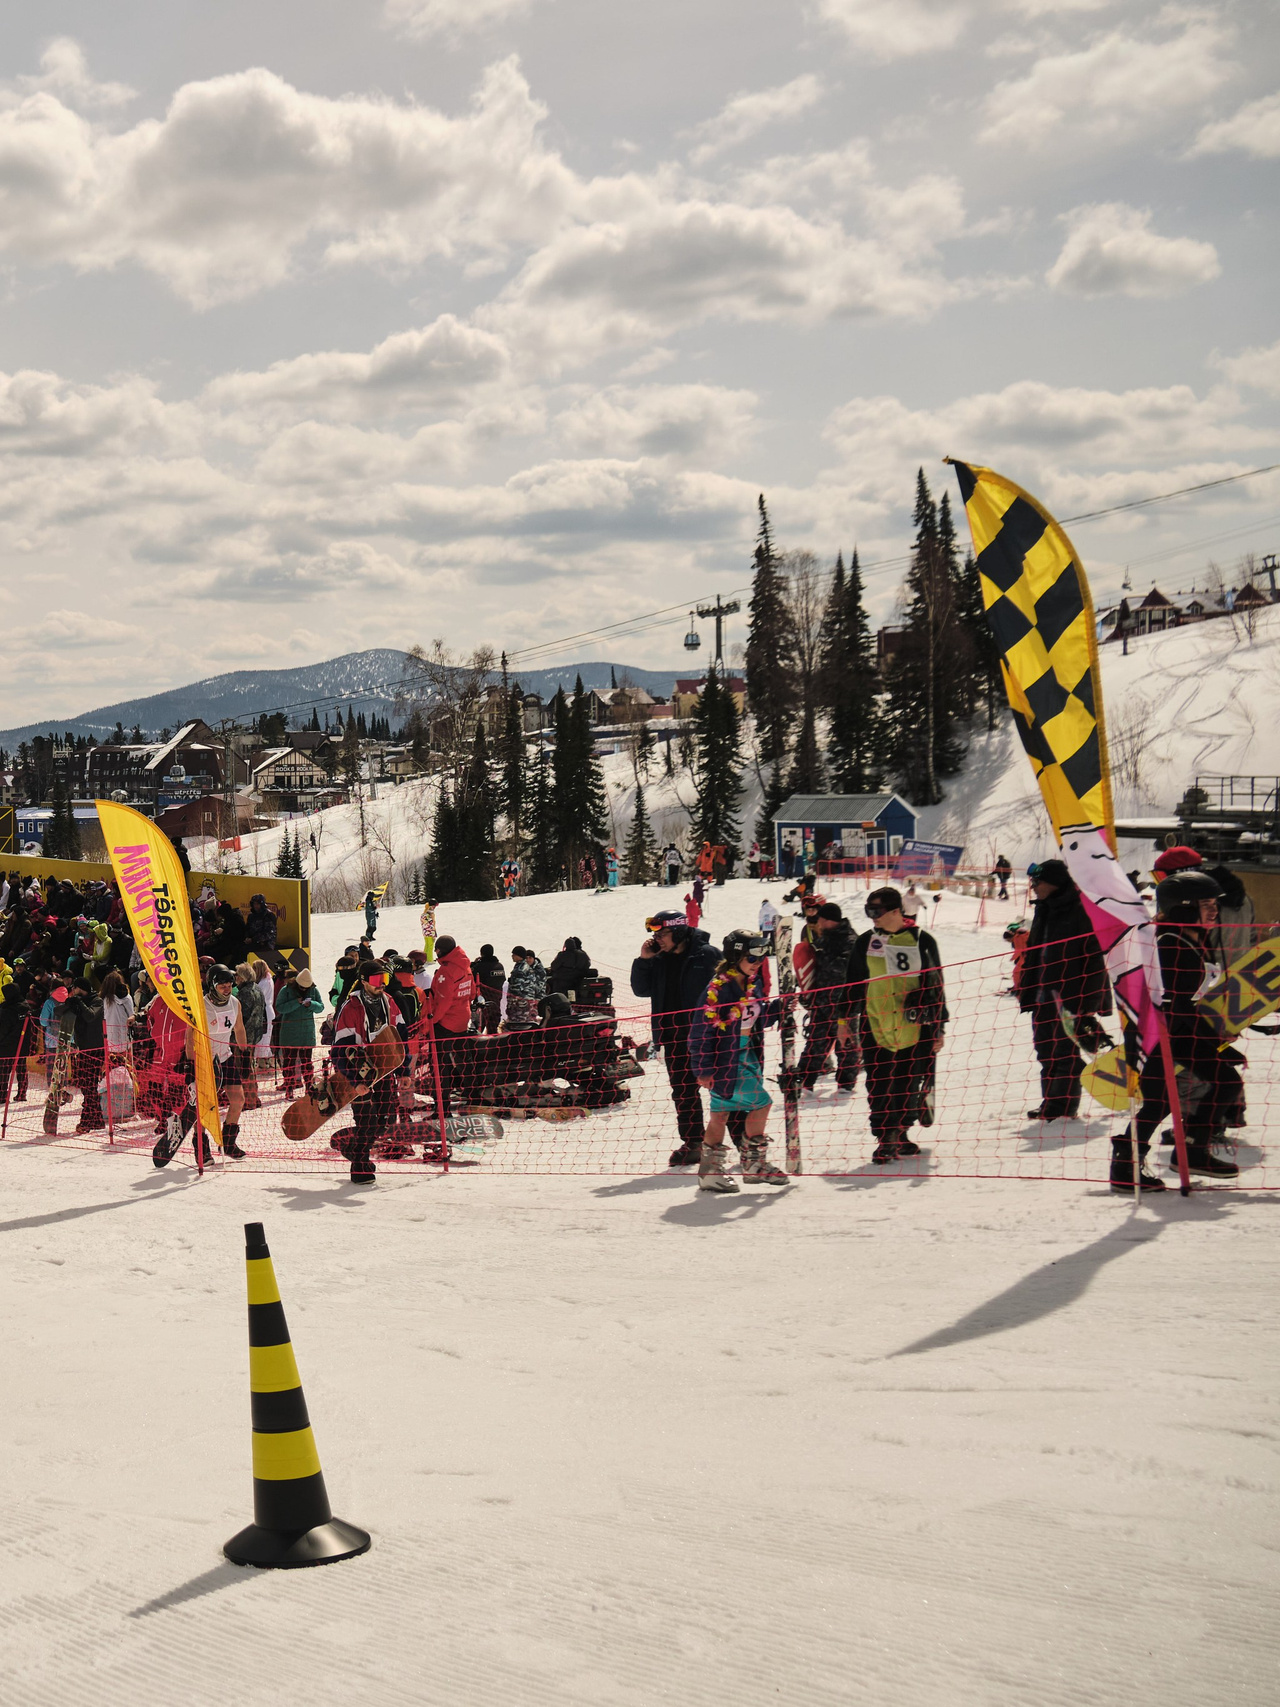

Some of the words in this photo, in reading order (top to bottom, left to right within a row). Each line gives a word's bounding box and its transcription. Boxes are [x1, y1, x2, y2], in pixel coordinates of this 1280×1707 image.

[896, 952, 910, 971] 8
[224, 1016, 232, 1029] 4
[453, 1117, 495, 1129] NIDE
